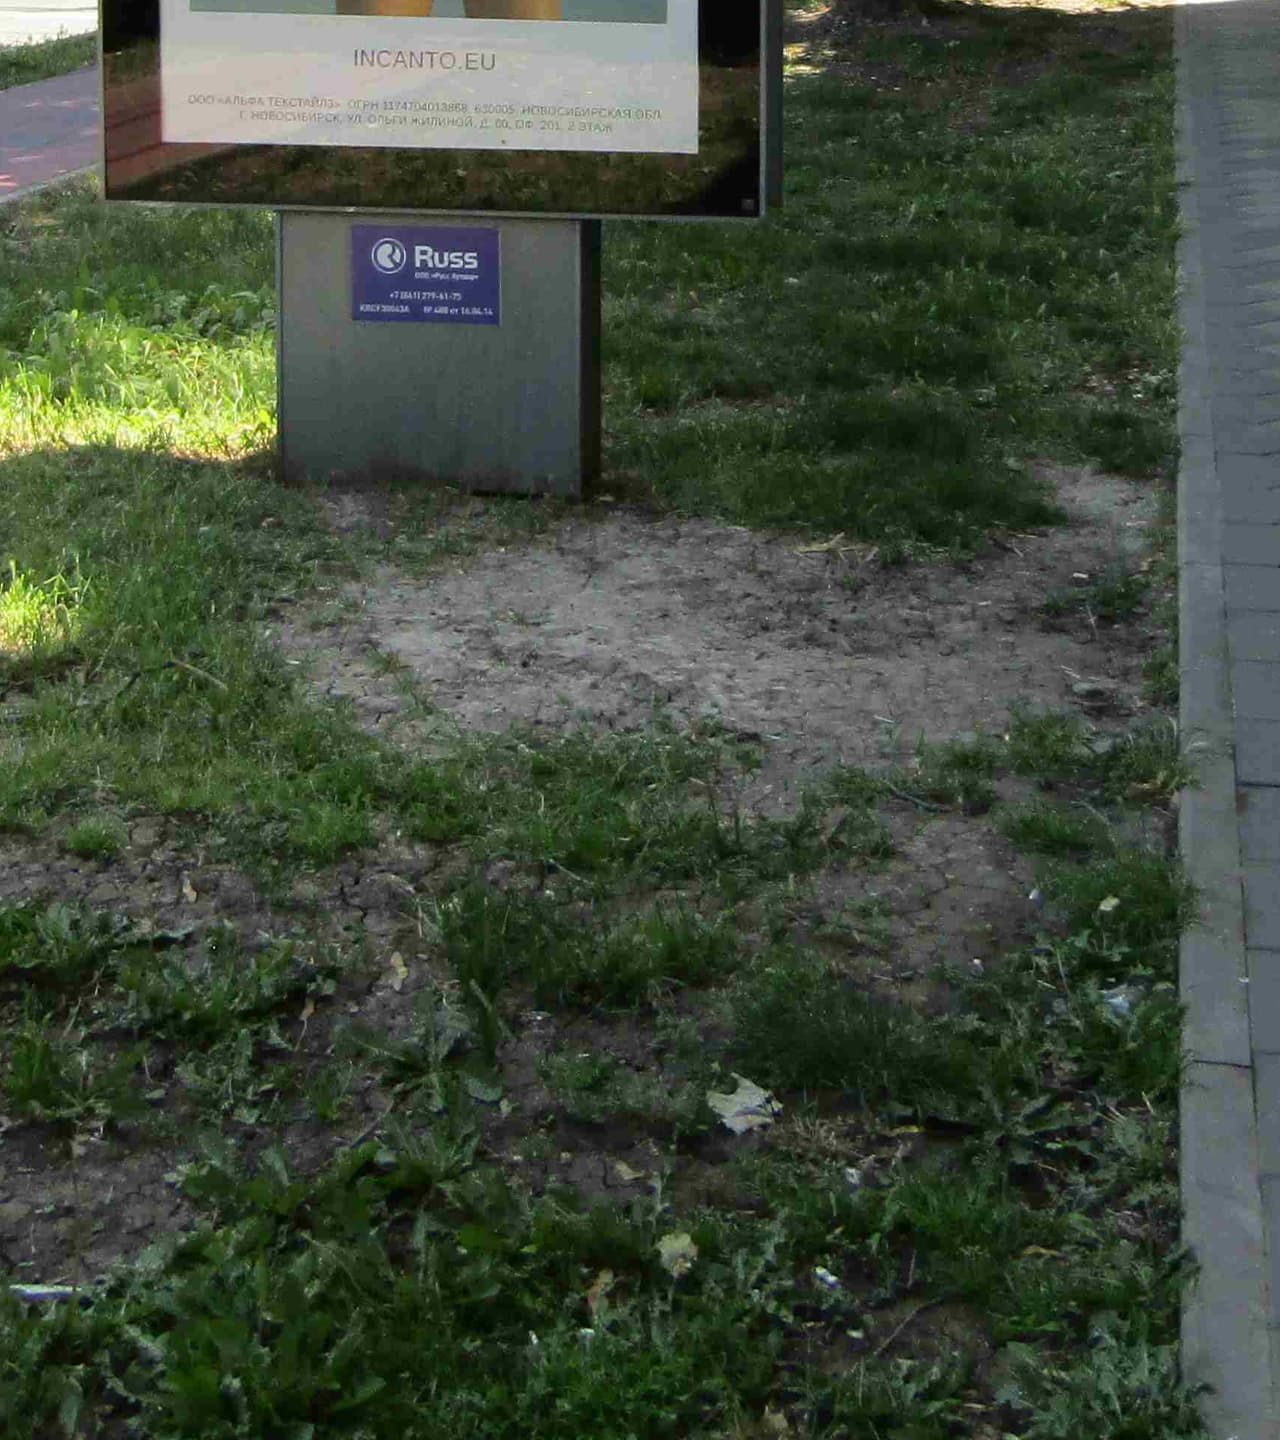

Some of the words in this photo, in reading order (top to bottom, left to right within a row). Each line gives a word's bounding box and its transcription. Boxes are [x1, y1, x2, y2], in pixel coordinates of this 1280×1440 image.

[354, 48, 496, 71] INCANTO.EU
[187, 95, 215, 106] ООО
[521, 104, 632, 120] НОВОСИБИРСКАЯ
[414, 244, 478, 269] Russ
